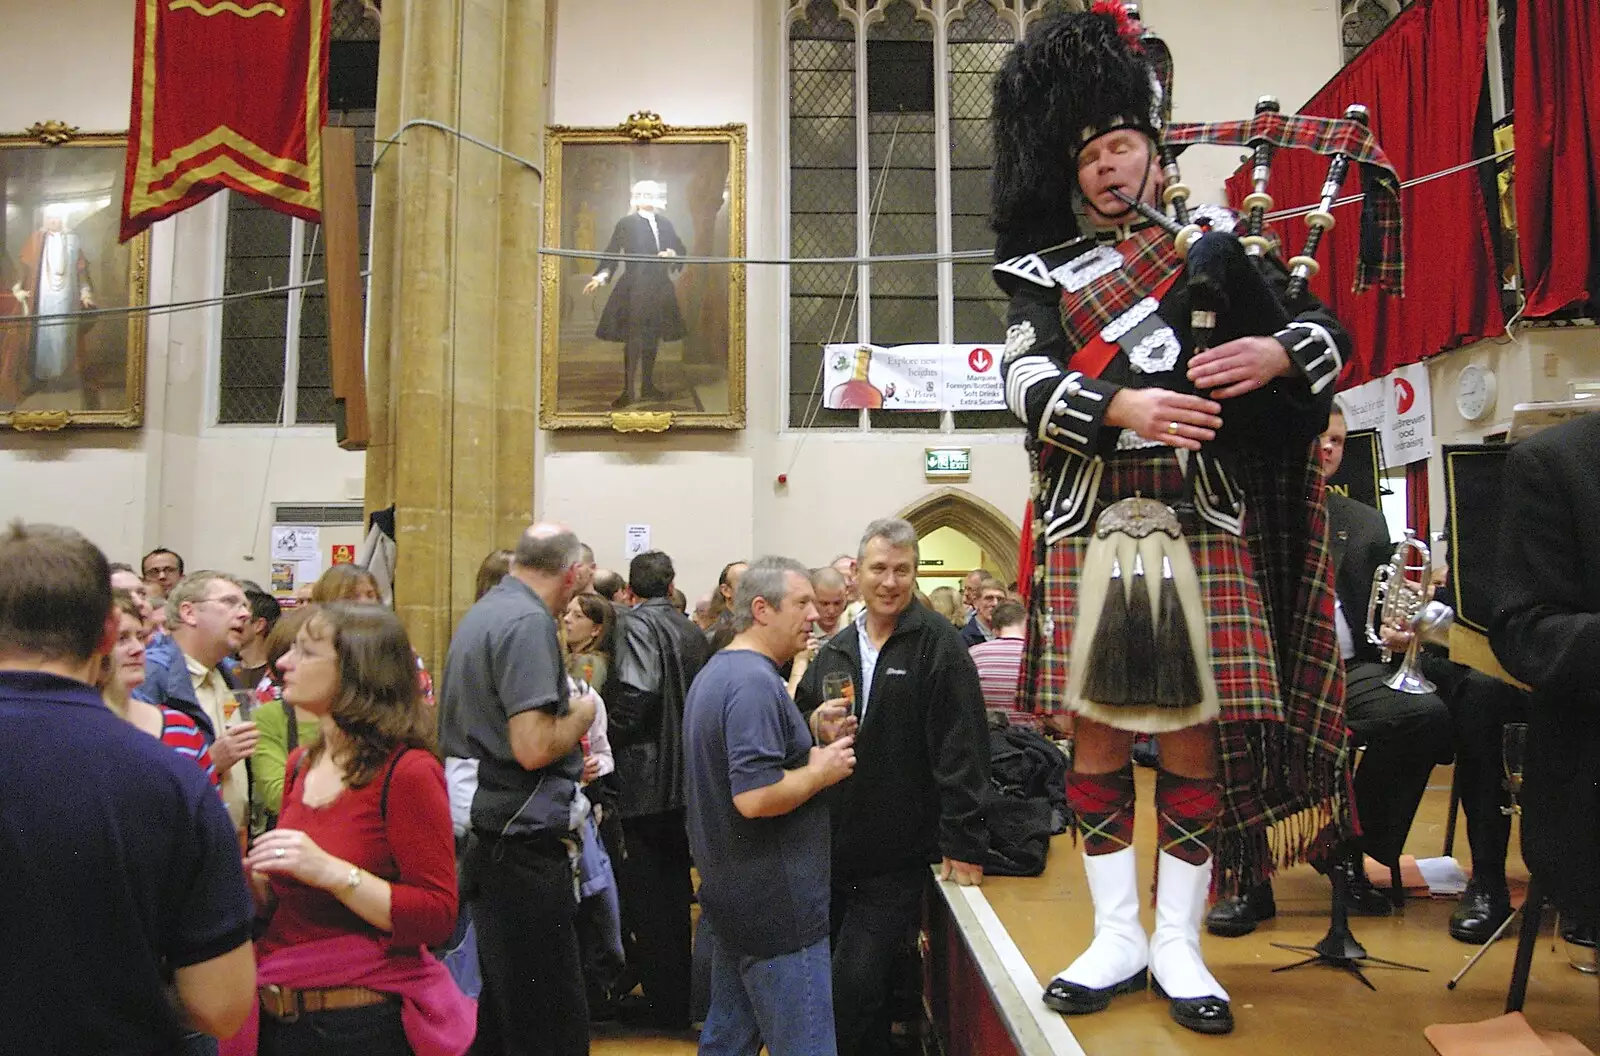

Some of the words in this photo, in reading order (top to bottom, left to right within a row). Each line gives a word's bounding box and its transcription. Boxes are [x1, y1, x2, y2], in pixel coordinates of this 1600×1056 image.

[887, 356, 919, 367] Explore
[908, 367, 938, 379] heights
[964, 390, 978, 398] Soft
[979, 390, 1000, 398] Drinks
[960, 398, 978, 406] Extra
